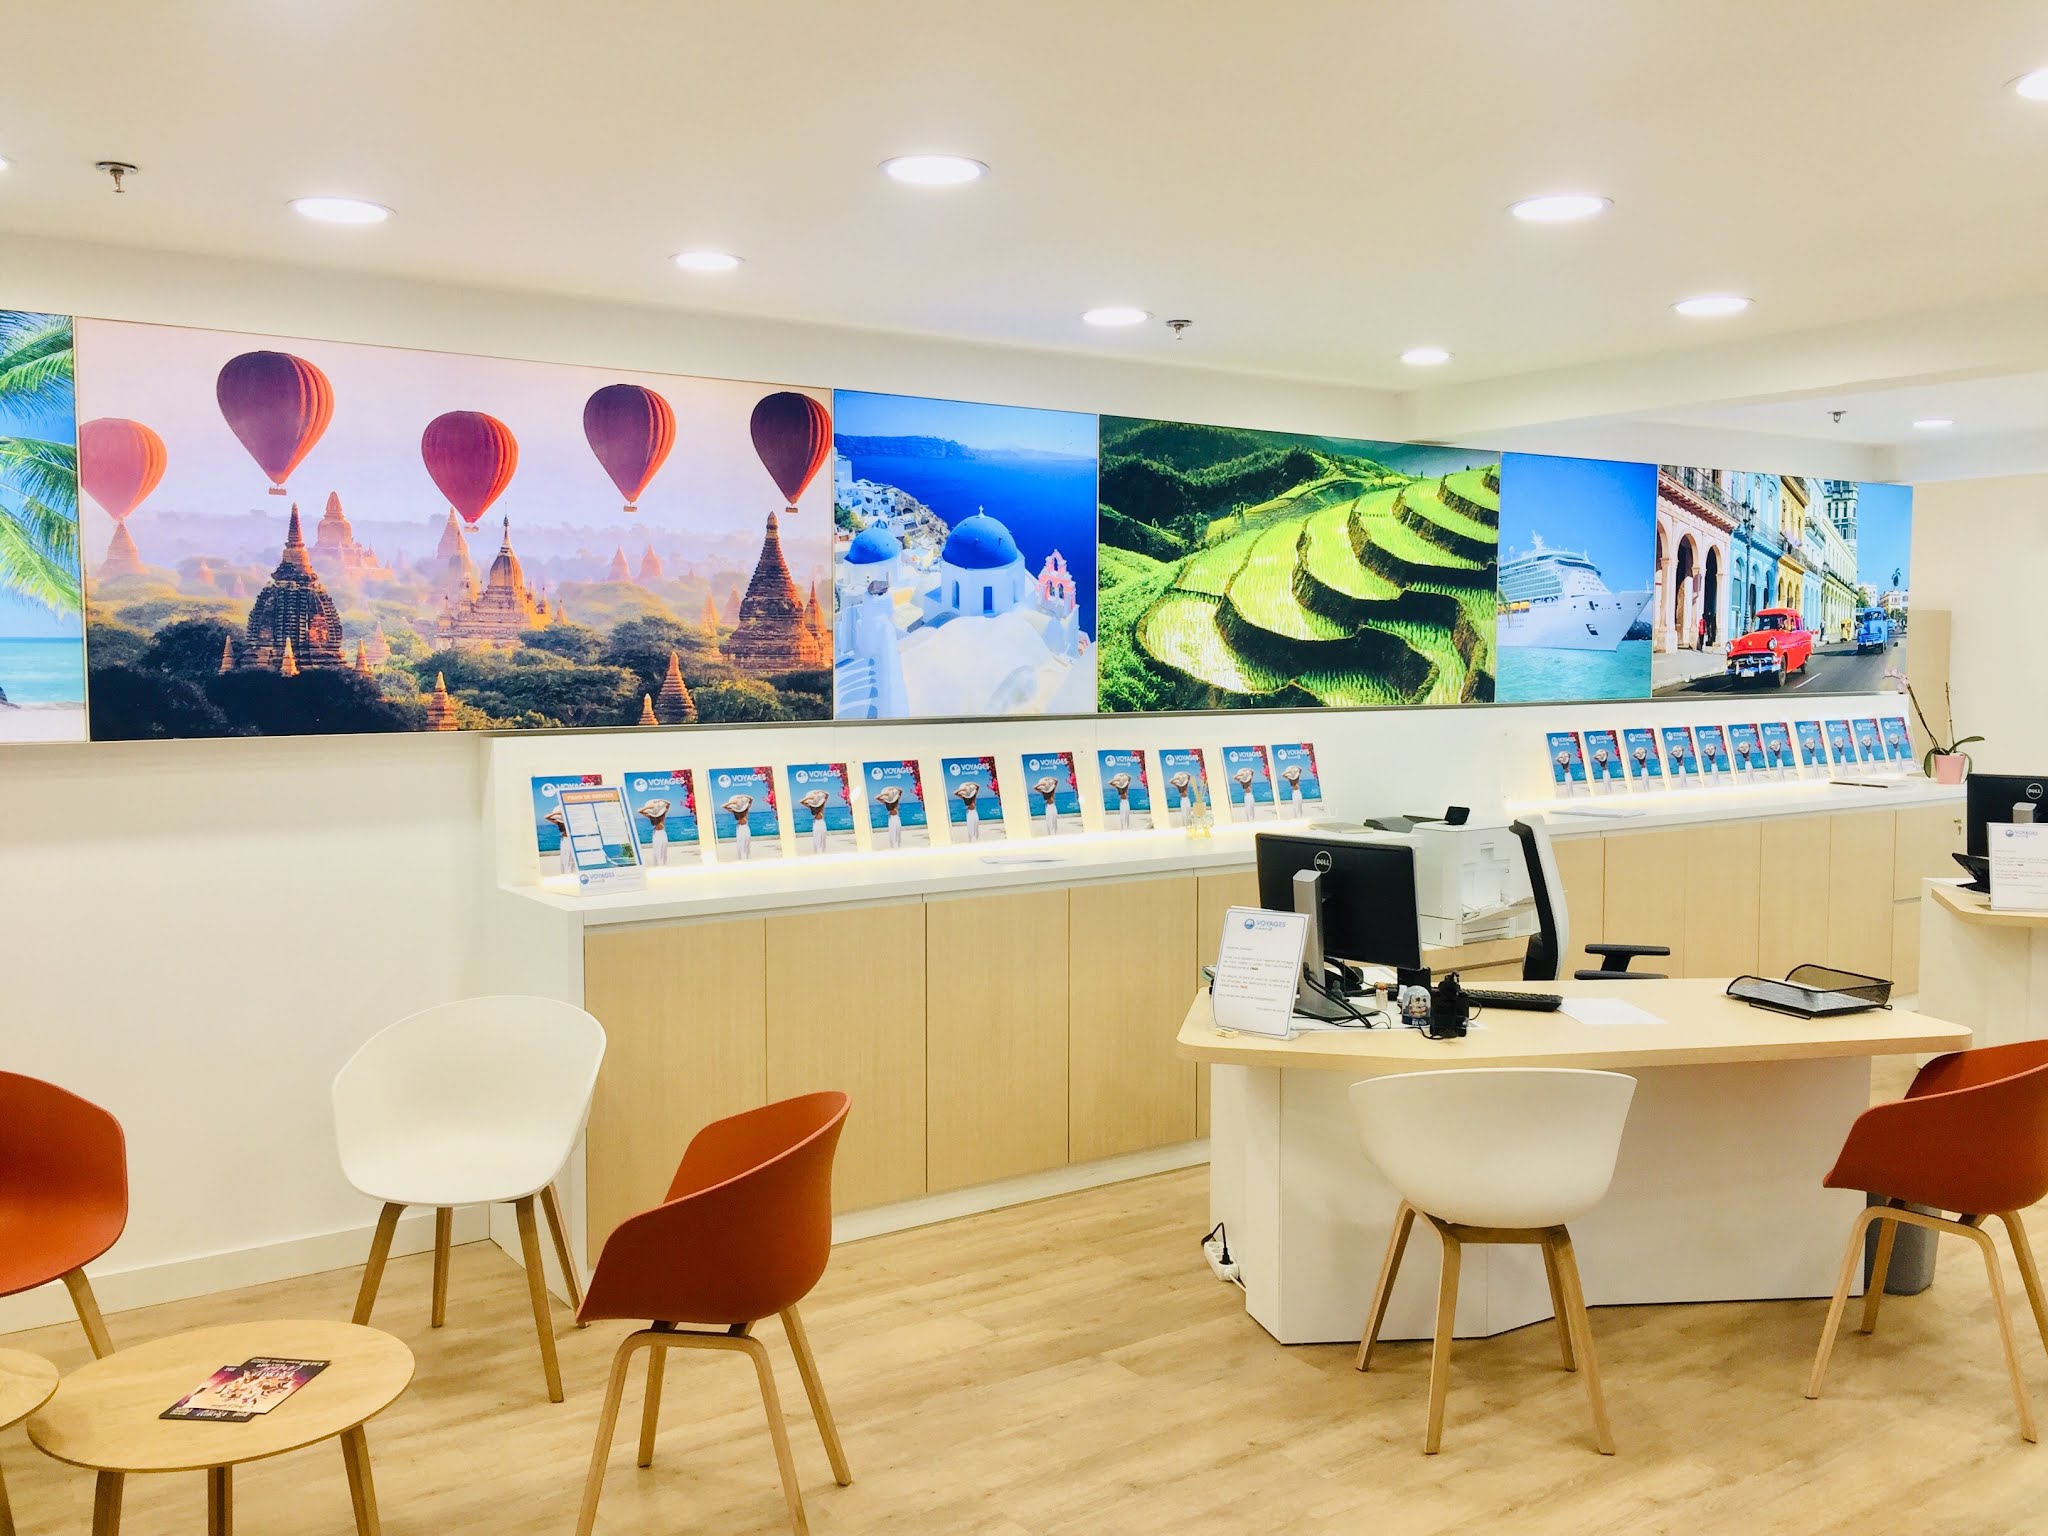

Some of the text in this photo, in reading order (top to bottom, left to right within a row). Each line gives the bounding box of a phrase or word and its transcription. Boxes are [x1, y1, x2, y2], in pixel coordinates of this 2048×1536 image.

[1040, 758, 1068, 766] VOYAGES
[961, 763, 990, 771] VOYAGES
[731, 774, 767, 782] VOYAGES
[809, 770, 842, 778] VOYAGES
[648, 777, 686, 786] VOYAGES
[1256, 920, 1286, 928] VOYAGES
